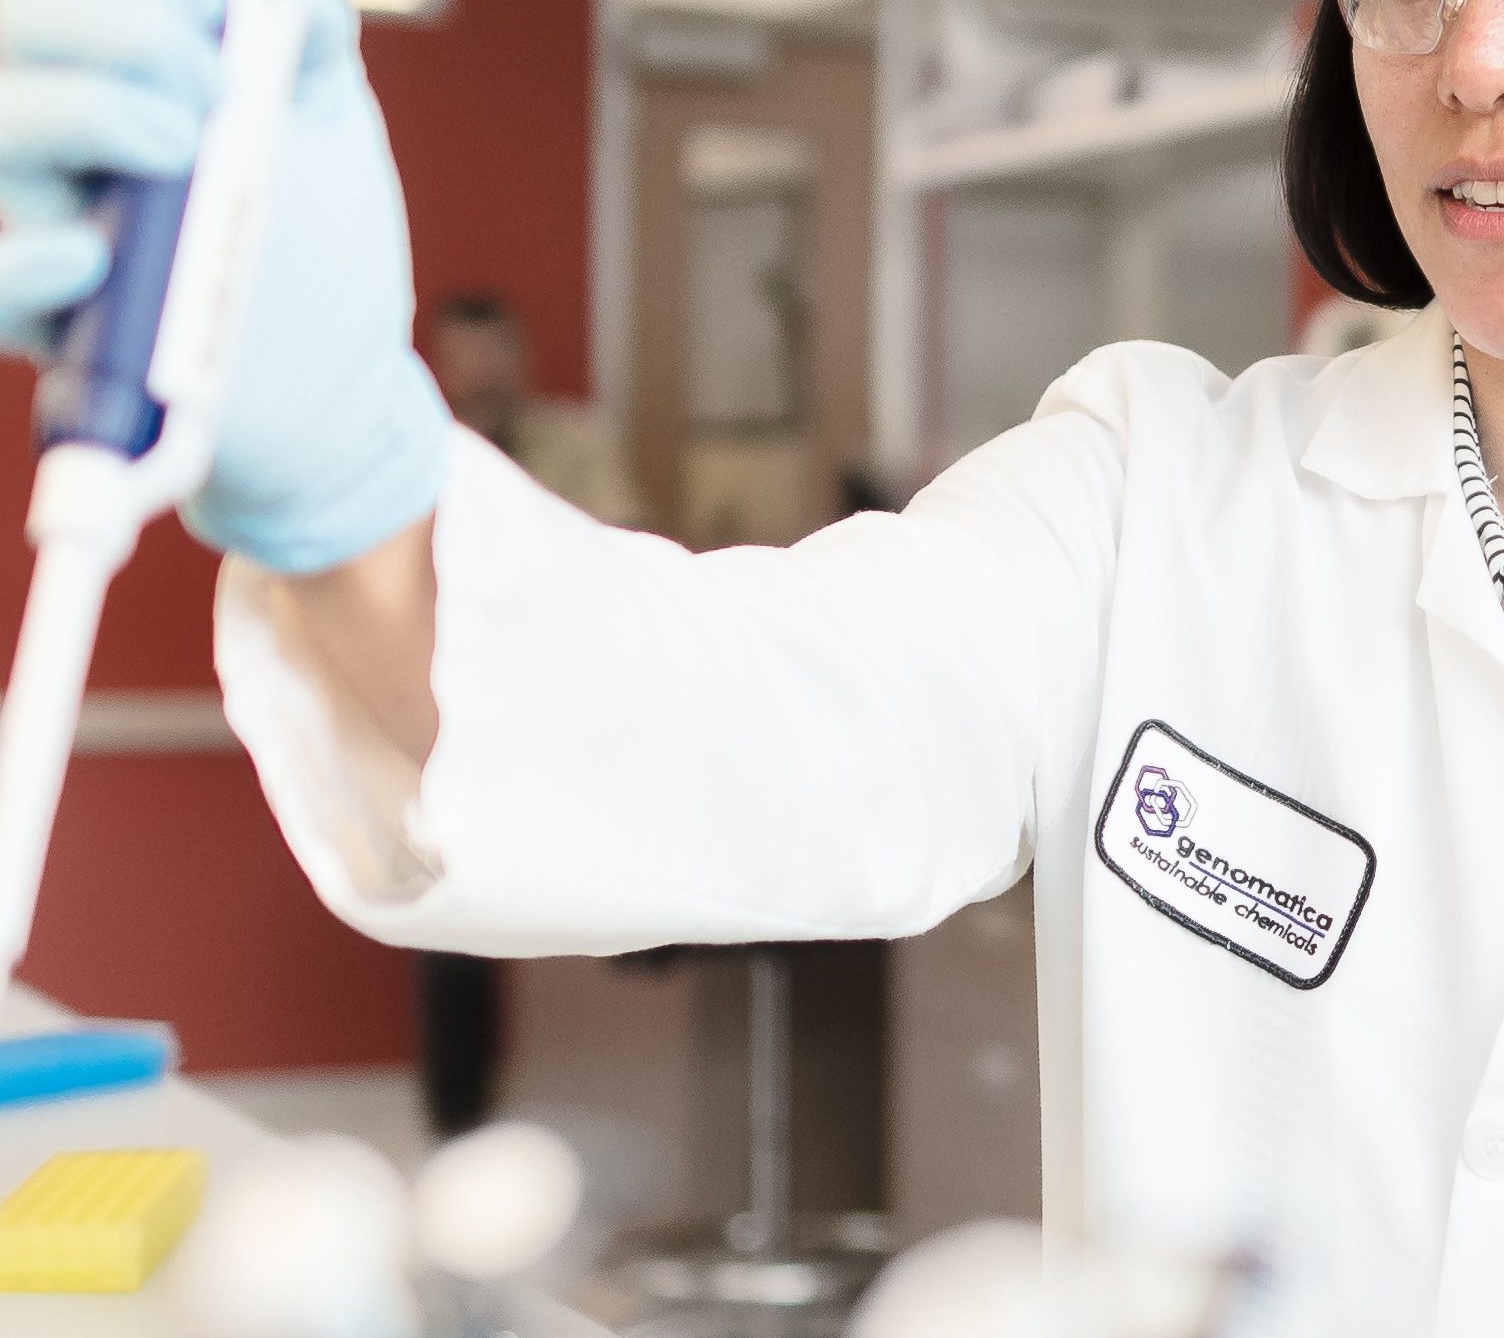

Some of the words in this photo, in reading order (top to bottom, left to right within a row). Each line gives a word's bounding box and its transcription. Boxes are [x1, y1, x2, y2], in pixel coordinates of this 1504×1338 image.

[1129, 835, 1228, 906] sustainable
[1234, 903, 1319, 956] chemicals
[1177, 834, 1334, 932] genomatica
